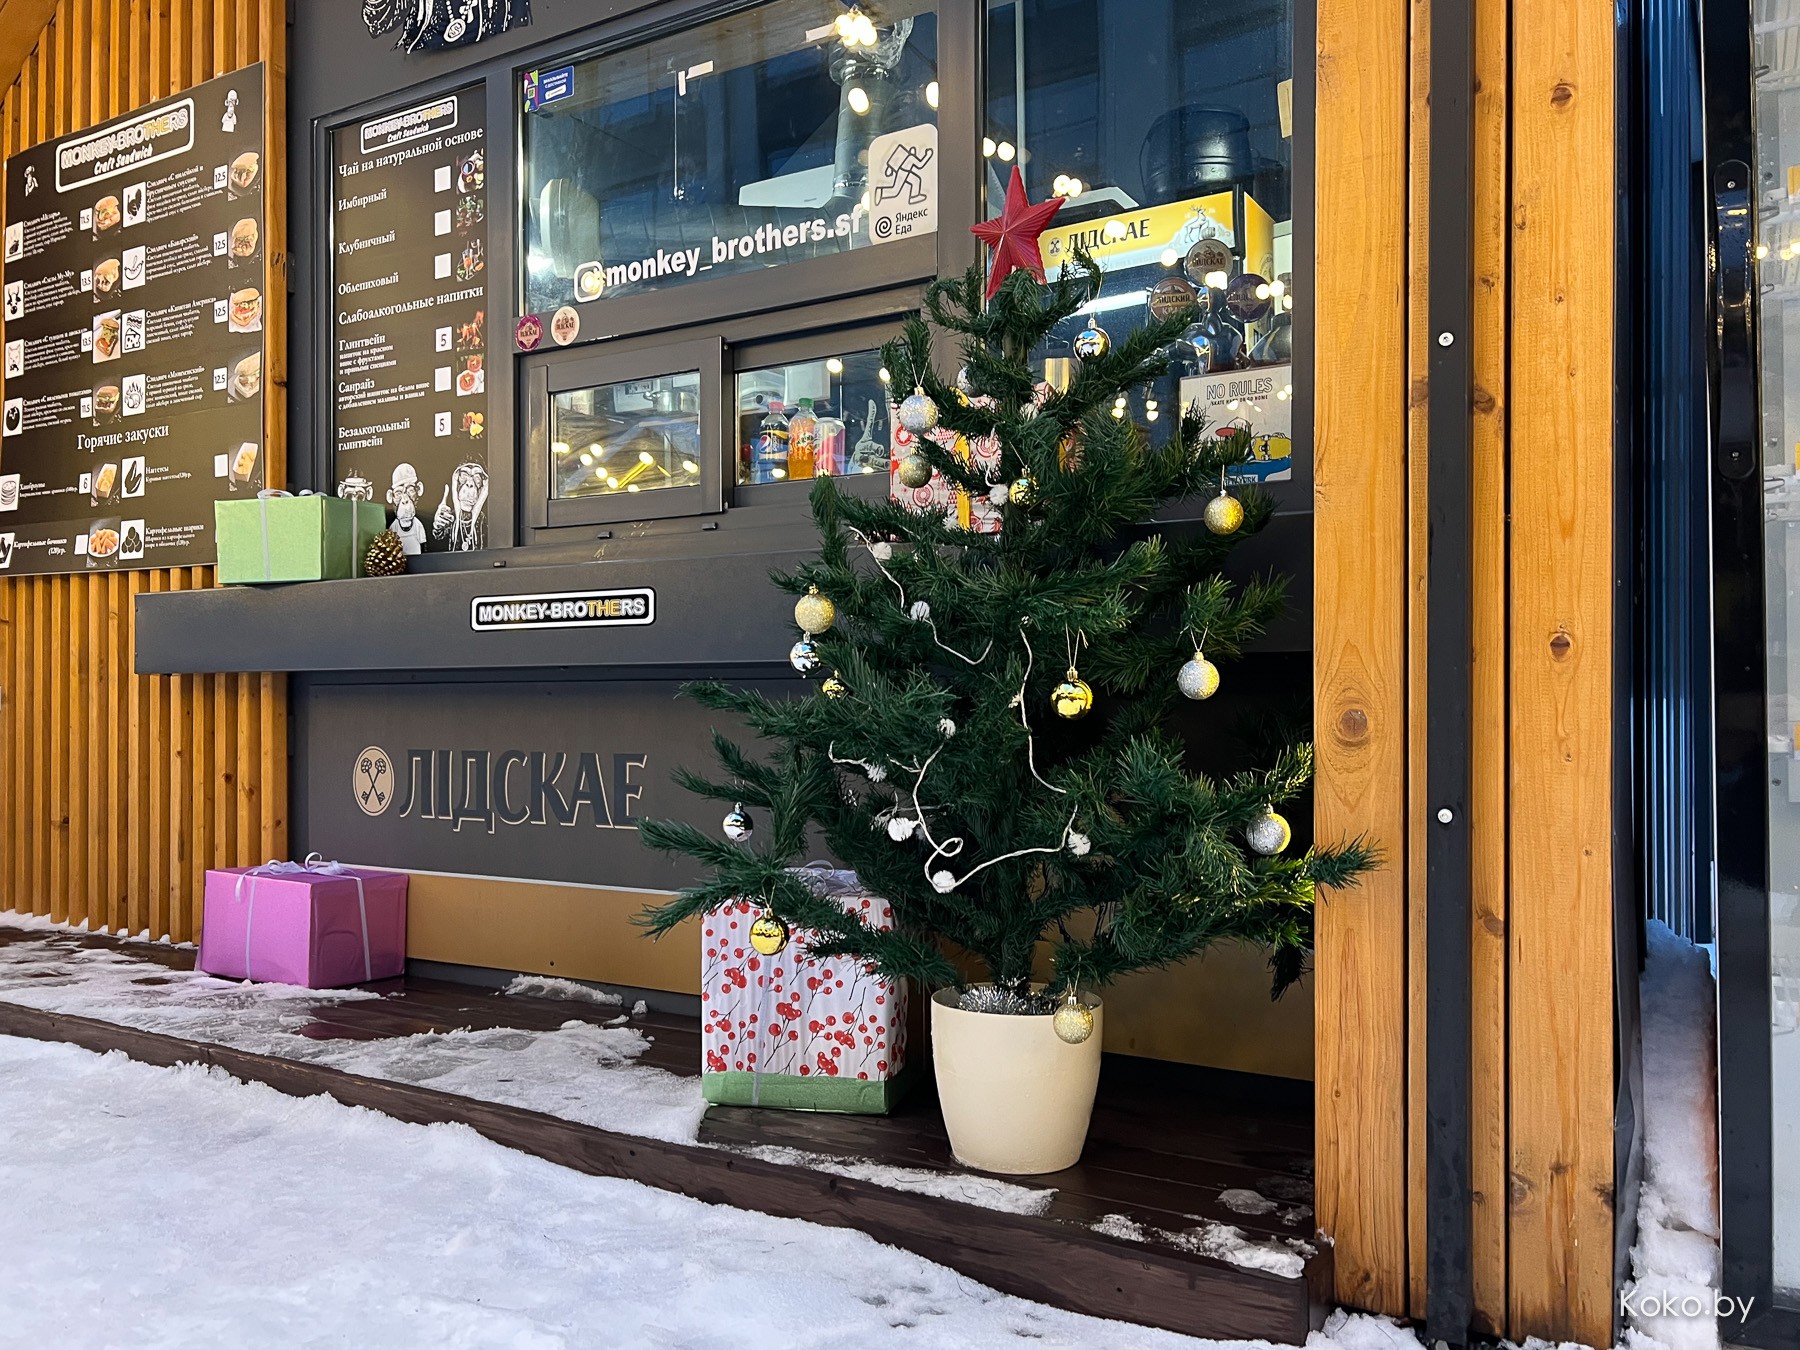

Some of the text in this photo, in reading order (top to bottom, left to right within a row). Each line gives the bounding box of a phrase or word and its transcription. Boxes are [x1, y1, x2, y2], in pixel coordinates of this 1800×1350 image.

[364, 102, 454, 140] MONKEY-BROTHERS
[60, 108, 189, 169] MONKEY-BROTHERS
[387, 124, 430, 143] Craft Sandwich
[94, 145, 154, 176] Craft Sandwich
[339, 128, 484, 178] Чай на натуральной основе
[215, 172, 226, 182] 12.5
[338, 188, 388, 211] Имбирный
[895, 208, 928, 223] Яндекс
[895, 224, 912, 236] Еда
[1066, 218, 1150, 253] ЛІДСАЕ
[215, 240, 226, 250] 12.5
[338, 230, 396, 255] Клубничный
[338, 272, 399, 295] Облепиховый
[215, 306, 226, 316] 12.5
[339, 287, 484, 325] Слабоалкогольные напитки
[339, 334, 386, 351] Глинтвейн
[440, 334, 447, 347] 5
[215, 375, 226, 384] 12.5
[339, 378, 375, 394] Санрайз
[1207, 377, 1273, 400] NO RULES
[339, 418, 410, 439] Безалкогольный
[440, 418, 445, 432] 5
[77, 424, 170, 453] Горячие закуски
[339, 436, 383, 451] глинтвейн
[84, 478, 88, 489] 6
[478, 598, 645, 622] MONKEY-BROTHERS
[400, 748, 648, 834] ЛІДСКАЕ
